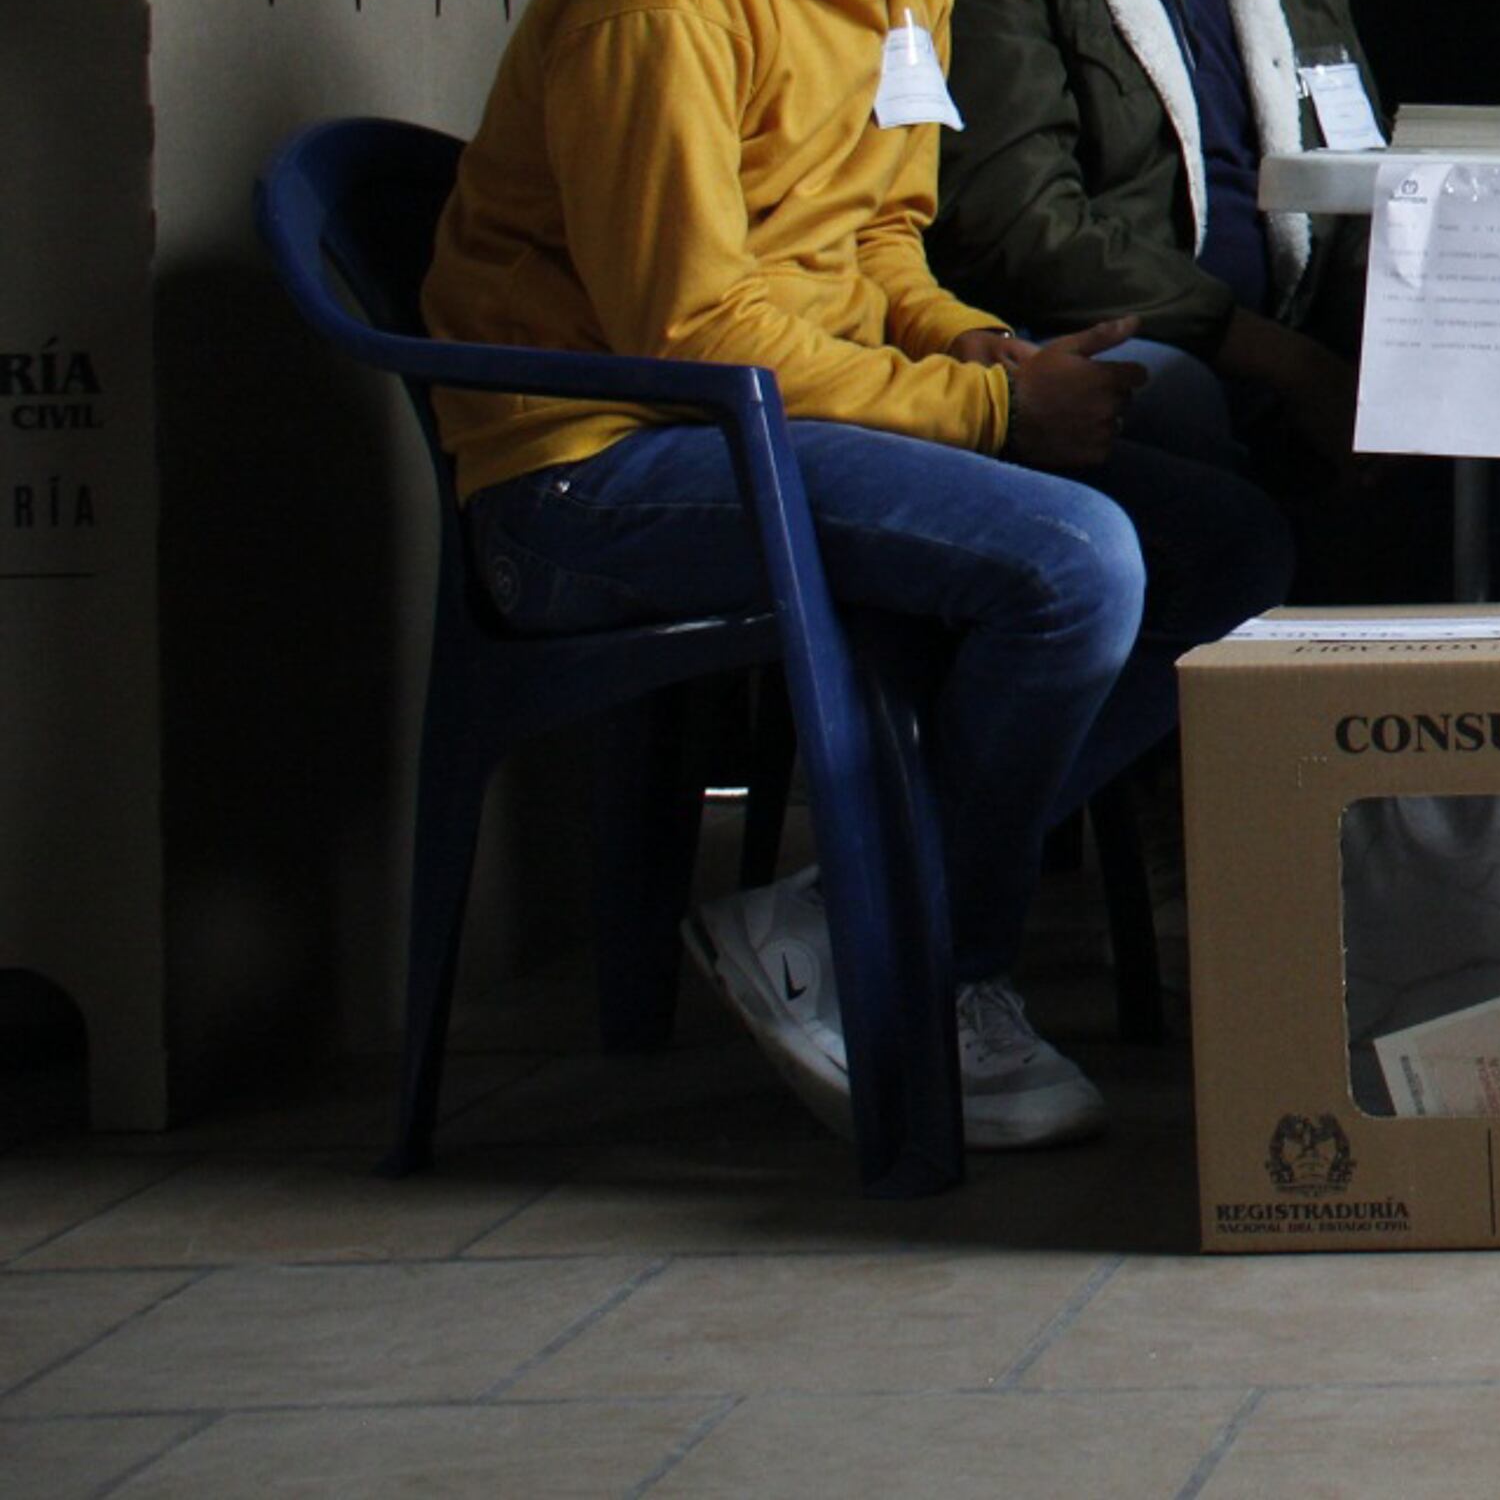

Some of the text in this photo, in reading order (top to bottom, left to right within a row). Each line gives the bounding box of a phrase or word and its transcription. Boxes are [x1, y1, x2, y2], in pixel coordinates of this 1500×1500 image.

[11, 404, 104, 430] CIVIL
[1216, 1196, 1409, 1221] REGISTRADURÍA
[1217, 1219, 1410, 1235] NACIONAL DEL ESTADO CIVIL
